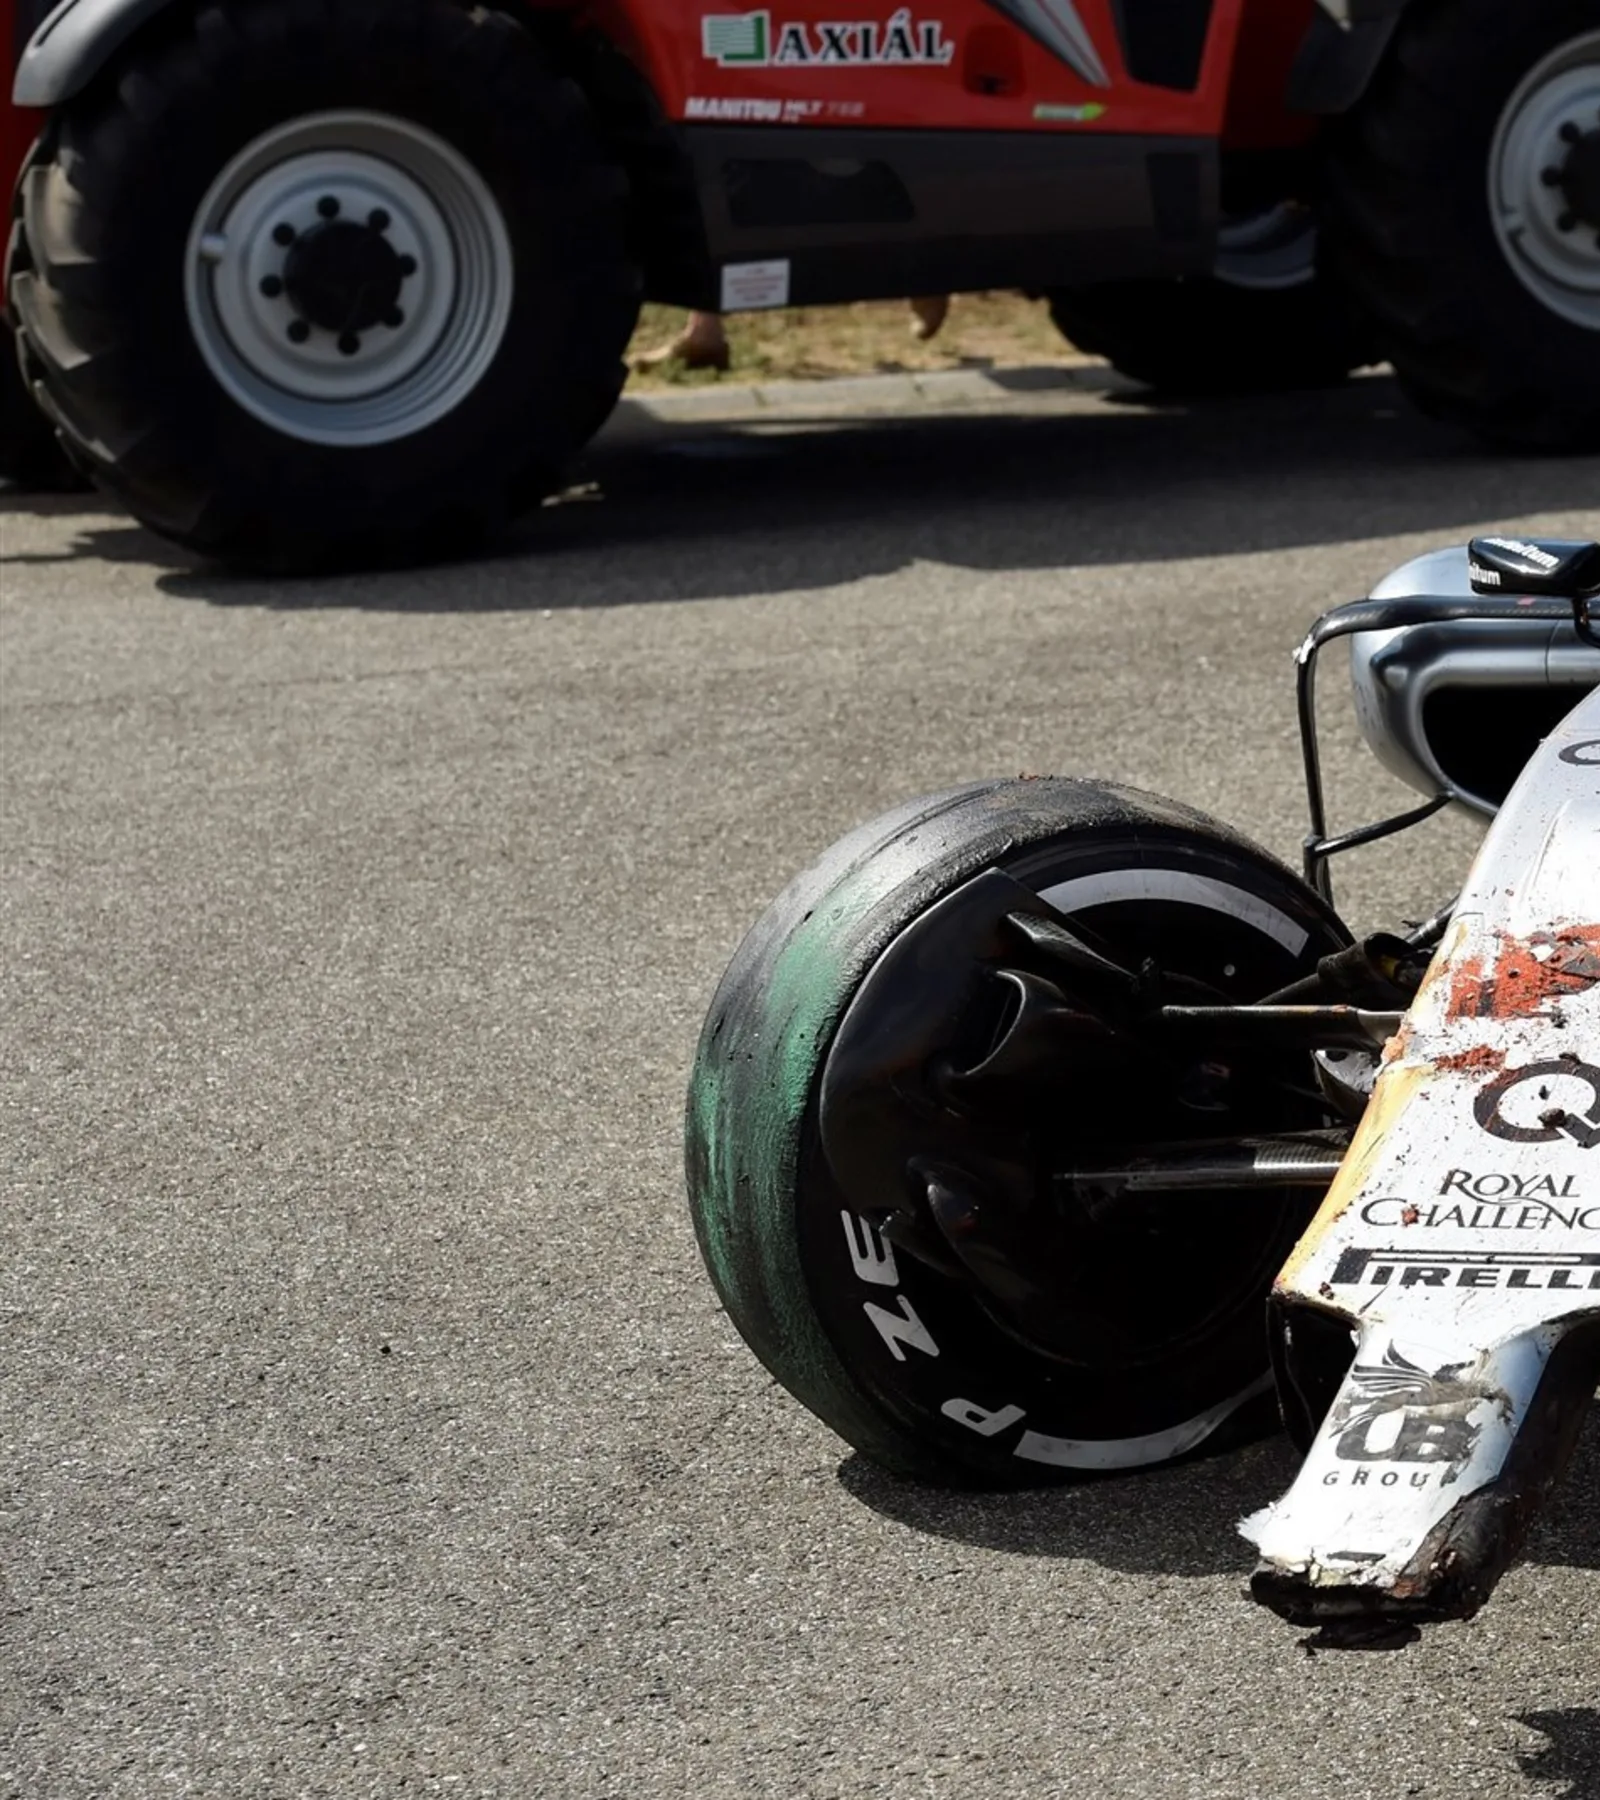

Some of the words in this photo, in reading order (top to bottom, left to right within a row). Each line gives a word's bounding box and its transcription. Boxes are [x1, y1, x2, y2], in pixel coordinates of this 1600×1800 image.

[775, 9, 953, 65] AXIÁL
[1438, 1168, 1581, 1205] ROYAL
[840, 1208, 941, 1362] ZE
